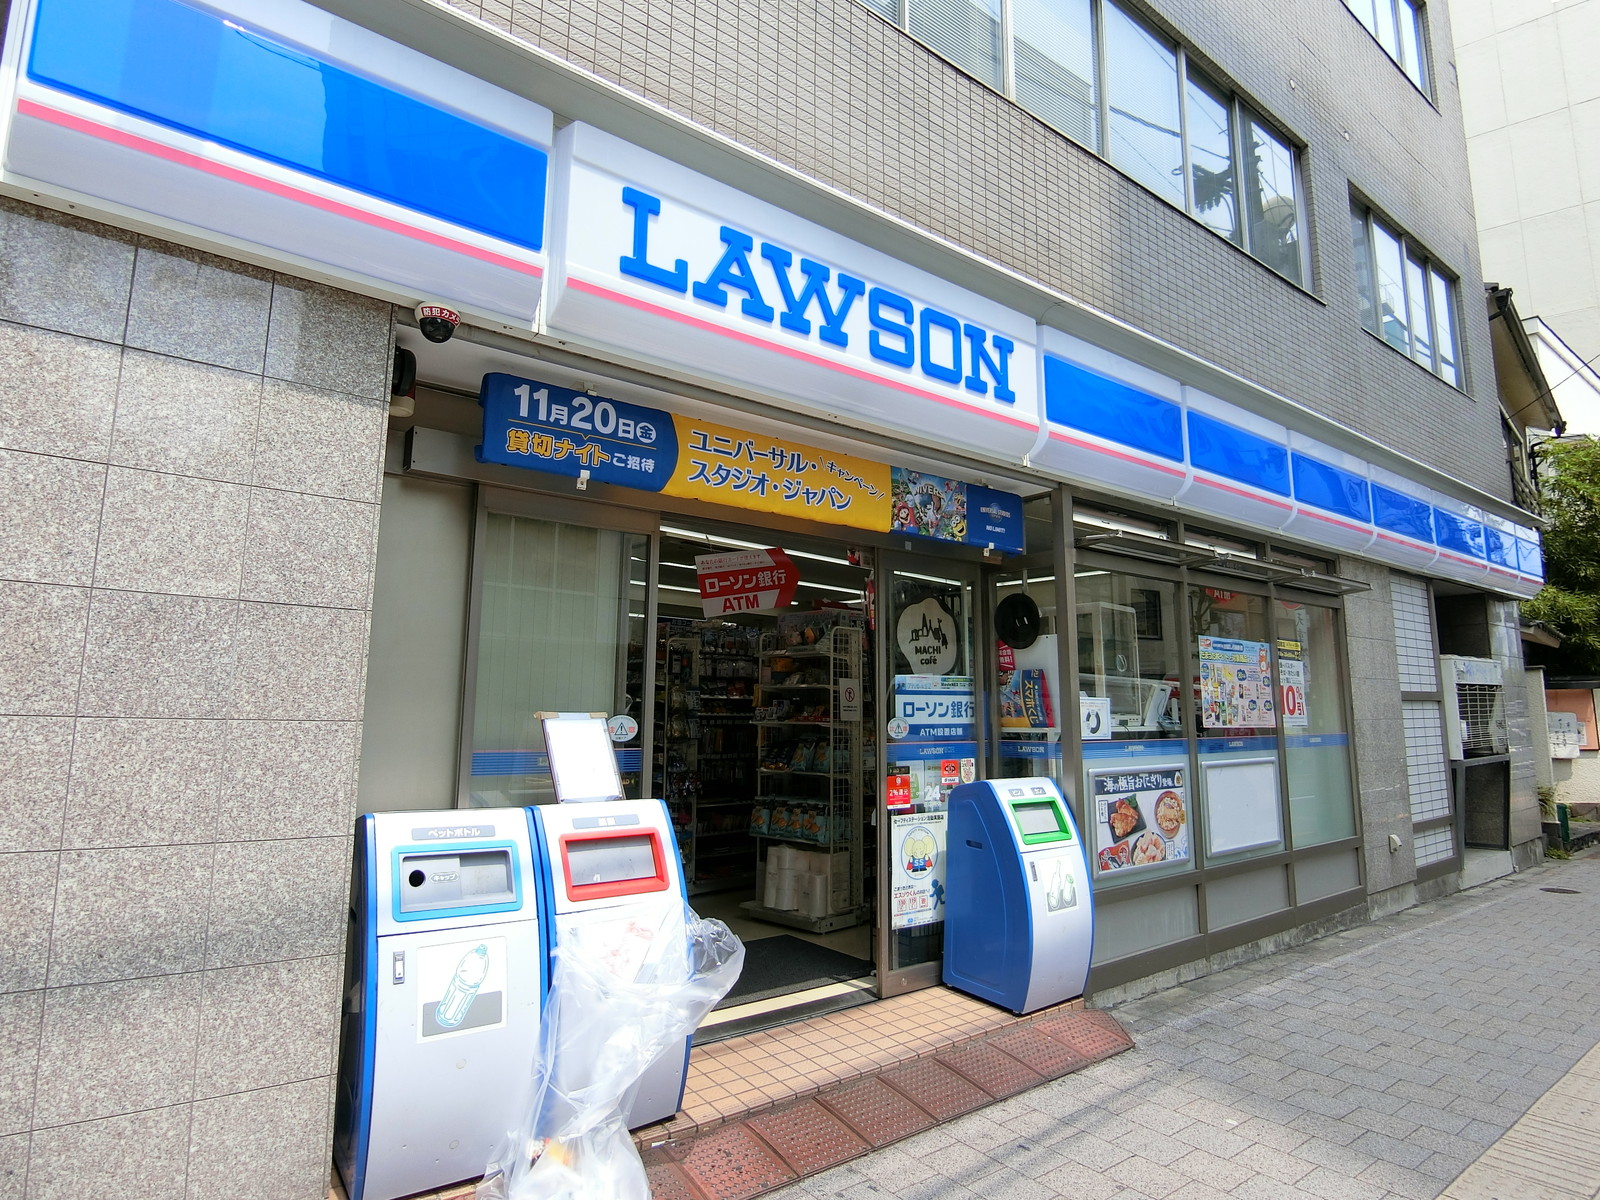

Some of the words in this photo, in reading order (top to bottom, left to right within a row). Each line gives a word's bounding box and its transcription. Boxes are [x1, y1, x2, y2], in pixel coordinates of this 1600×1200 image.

[619, 186, 1015, 403] LAWSON
[422, 307, 460, 324] 防犯カメラ
[688, 459, 852, 510] スタジオ・ジャパン
[826, 461, 878, 496] キャンペーン
[705, 569, 787, 593] ローソン銀行
[722, 594, 760, 612] ATM
[915, 645, 941, 655] MACHI
[903, 701, 975, 718] ローソン銀行
[1024, 680, 1039, 724] スマホくじ
[1018, 745, 1044, 753] LAWSON
[427, 827, 481, 838] ペットボトル
[432, 873, 456, 882] キャップ
